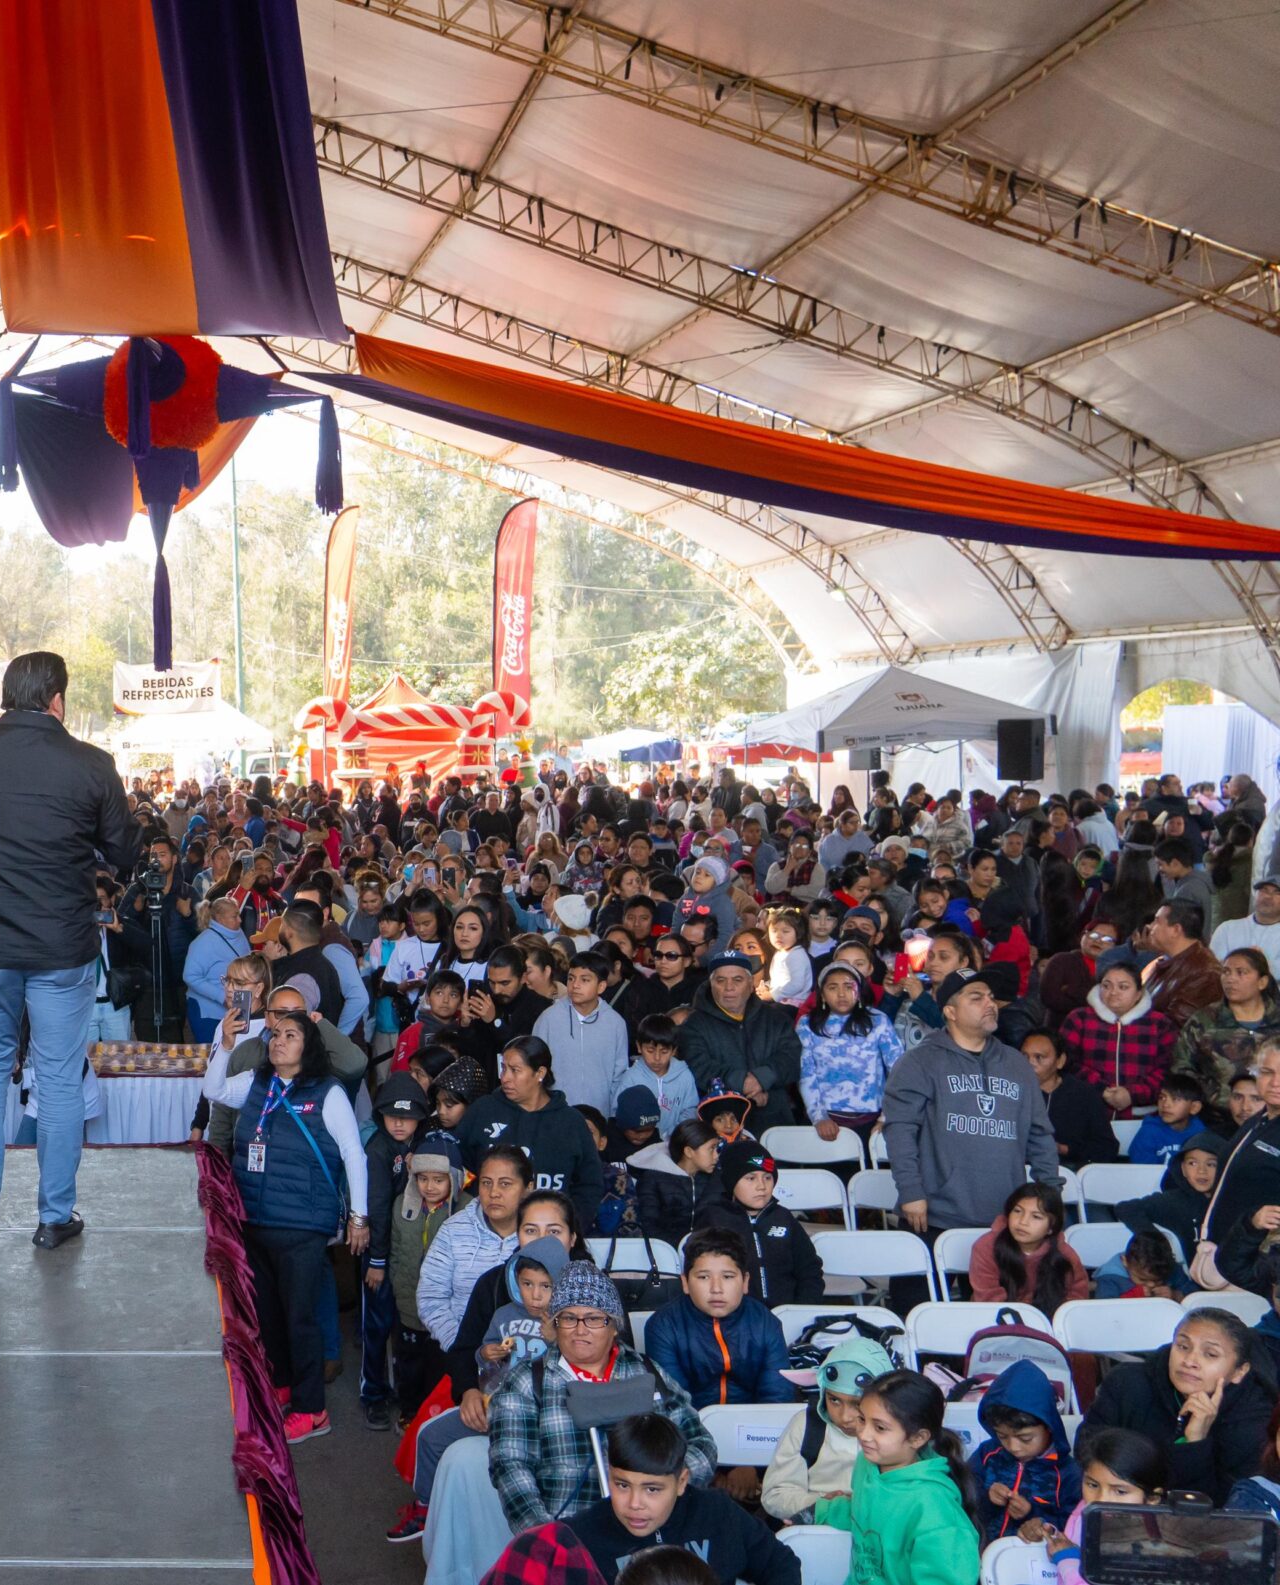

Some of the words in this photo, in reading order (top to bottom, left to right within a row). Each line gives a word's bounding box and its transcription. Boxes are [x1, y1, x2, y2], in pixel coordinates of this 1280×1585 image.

[142, 677, 194, 688] BEBIDAS
[122, 687, 214, 700] REFRESCANTES
[893, 703, 945, 712] TIJUANA
[947, 1074, 1019, 1100] RAIERS
[946, 1113, 1017, 1140] FOOTBALL
[500, 1318, 544, 1339] LEGE
